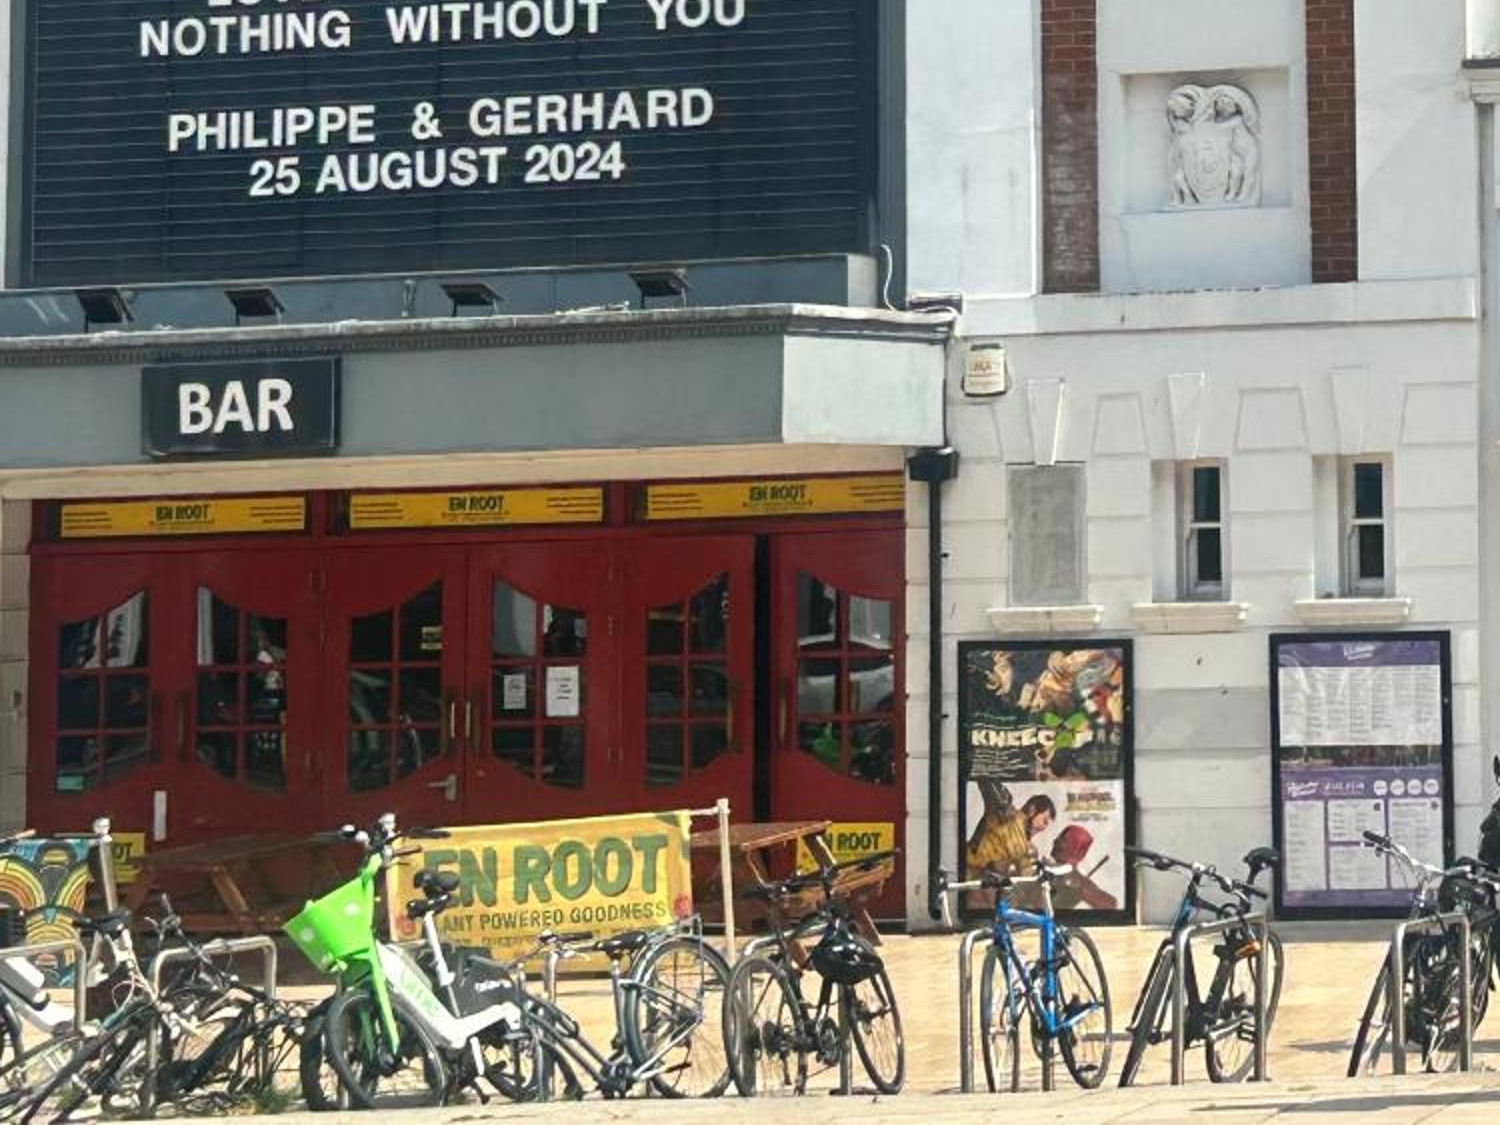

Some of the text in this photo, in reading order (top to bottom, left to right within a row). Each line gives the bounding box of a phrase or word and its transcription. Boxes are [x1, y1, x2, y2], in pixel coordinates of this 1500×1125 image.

[139, 9, 351, 57] NOTHING
[167, 87, 715, 152] PHILIPPE & GERHARD
[249, 140, 627, 196] 25 AUGUST 2024
[178, 378, 294, 435] BAR
[470, 495, 505, 511] ROOT
[770, 484, 808, 501] ROOT
[174, 504, 210, 520] ROOT
[970, 728, 1094, 748] KNEECP
[837, 832, 882, 851] ROOT
[512, 832, 669, 906] ROOT
[480, 906, 563, 931] POWERED
[570, 901, 668, 925] GOODNESS
